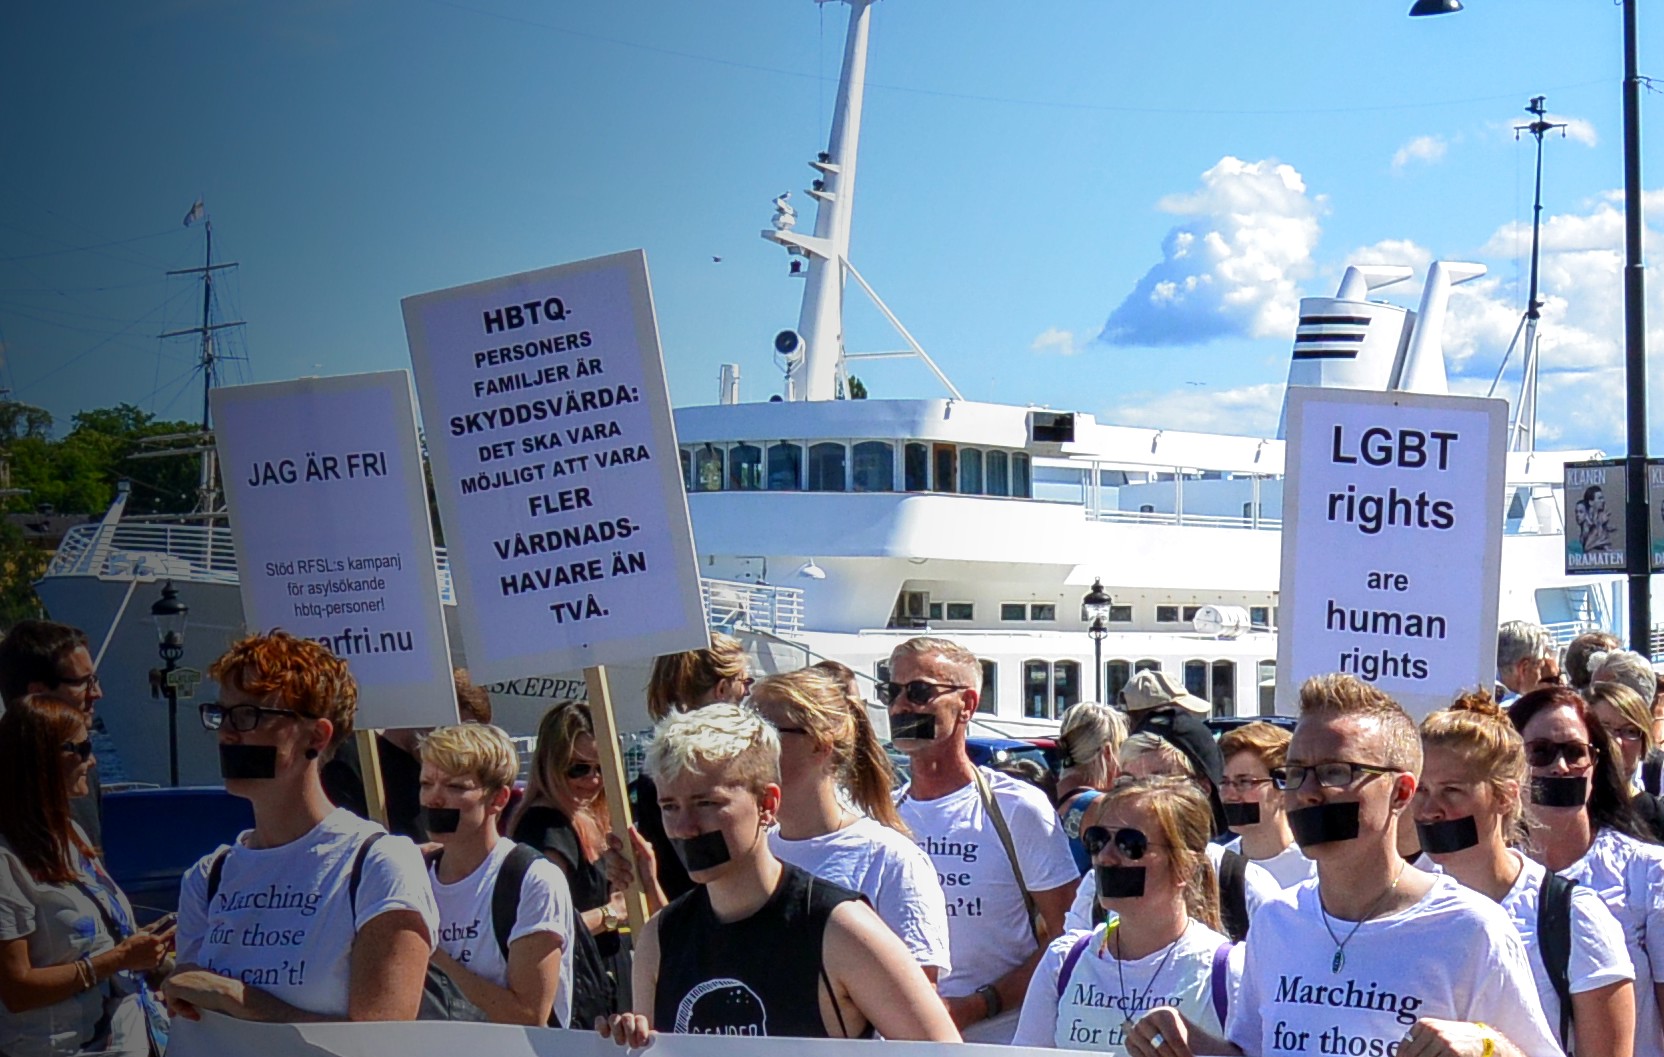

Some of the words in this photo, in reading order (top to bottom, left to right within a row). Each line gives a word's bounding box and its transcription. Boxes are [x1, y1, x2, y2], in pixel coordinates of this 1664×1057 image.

[483, 298, 572, 333] HBTQ-
[474, 331, 592, 368] PERSONERS
[474, 364, 570, 397] FAMILJER
[576, 358, 603, 378] ÄR
[450, 384, 639, 436] SKYDDSVÄRDA:
[478, 440, 515, 462] DET
[522, 432, 563, 453] SKA
[566, 421, 622, 444] VARA
[1332, 426, 1458, 470] LGBT
[248, 460, 297, 486] JAG
[306, 452, 340, 482] ÄR
[346, 452, 387, 478] FRI
[461, 463, 546, 494] MÖJLIGT
[552, 456, 589, 478] ATT
[595, 445, 650, 468] VARA
[1567, 469, 1606, 486] KLANEN
[528, 488, 593, 517] FLER
[1327, 486, 1454, 534] rights
[494, 517, 640, 560] VÅRDNADS-
[266, 561, 294, 576] Stöd
[298, 558, 344, 574] RFSL:s
[348, 553, 401, 570] kampanj
[501, 560, 604, 596] HAVARE
[612, 551, 646, 576] ÄN
[1568, 553, 1624, 566] DRAMATEN
[288, 582, 303, 596] för
[308, 577, 384, 597] asylsökande
[1367, 572, 1409, 592] are
[294, 598, 384, 618] hbtq-personer!
[550, 594, 608, 624] TVÅ.
[1326, 600, 1446, 640] human
[1339, 647, 1428, 682] rights
[209, 922, 234, 944] for
[242, 923, 305, 946] those
[241, 961, 305, 985] can’t!
[1274, 976, 1422, 1025] Marching
[1070, 1019, 1101, 1042] for
[1273, 1021, 1310, 1051] for
